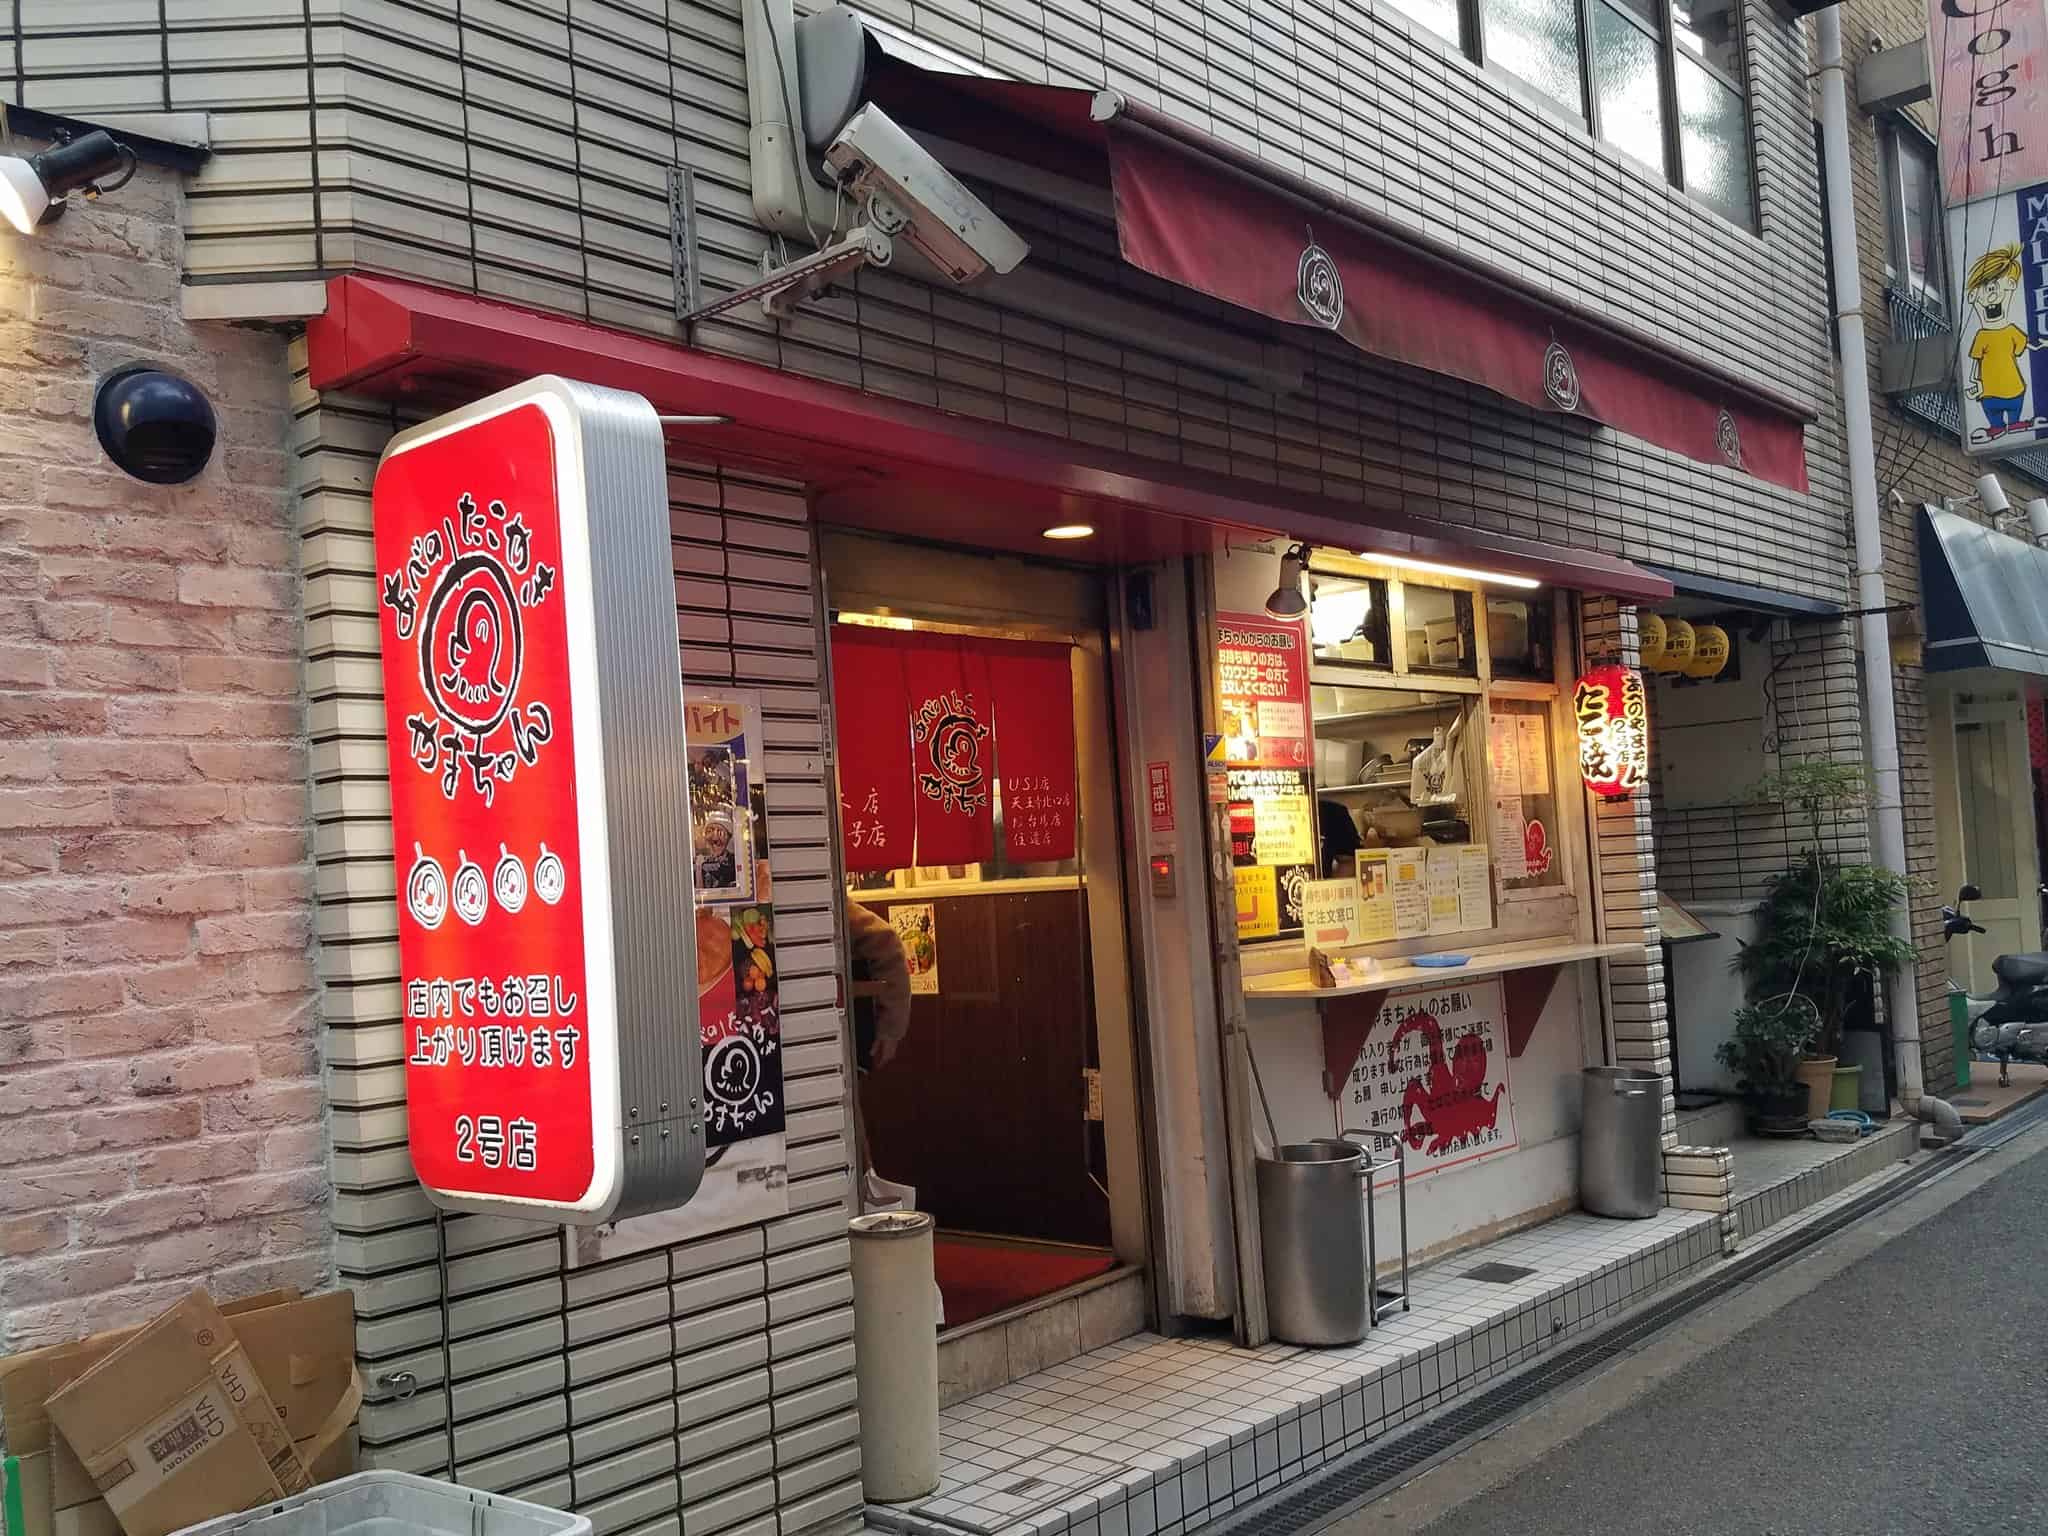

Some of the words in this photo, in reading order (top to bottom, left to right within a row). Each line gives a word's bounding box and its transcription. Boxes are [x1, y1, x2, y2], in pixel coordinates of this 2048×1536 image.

[407, 973, 577, 1018] 店内でもお召し
[409, 1024, 580, 1070] 上がり頂けます
[455, 1114, 538, 1171] 2号店
[221, 1364, 247, 1402] CHA
[195, 1394, 225, 1437] CHA
